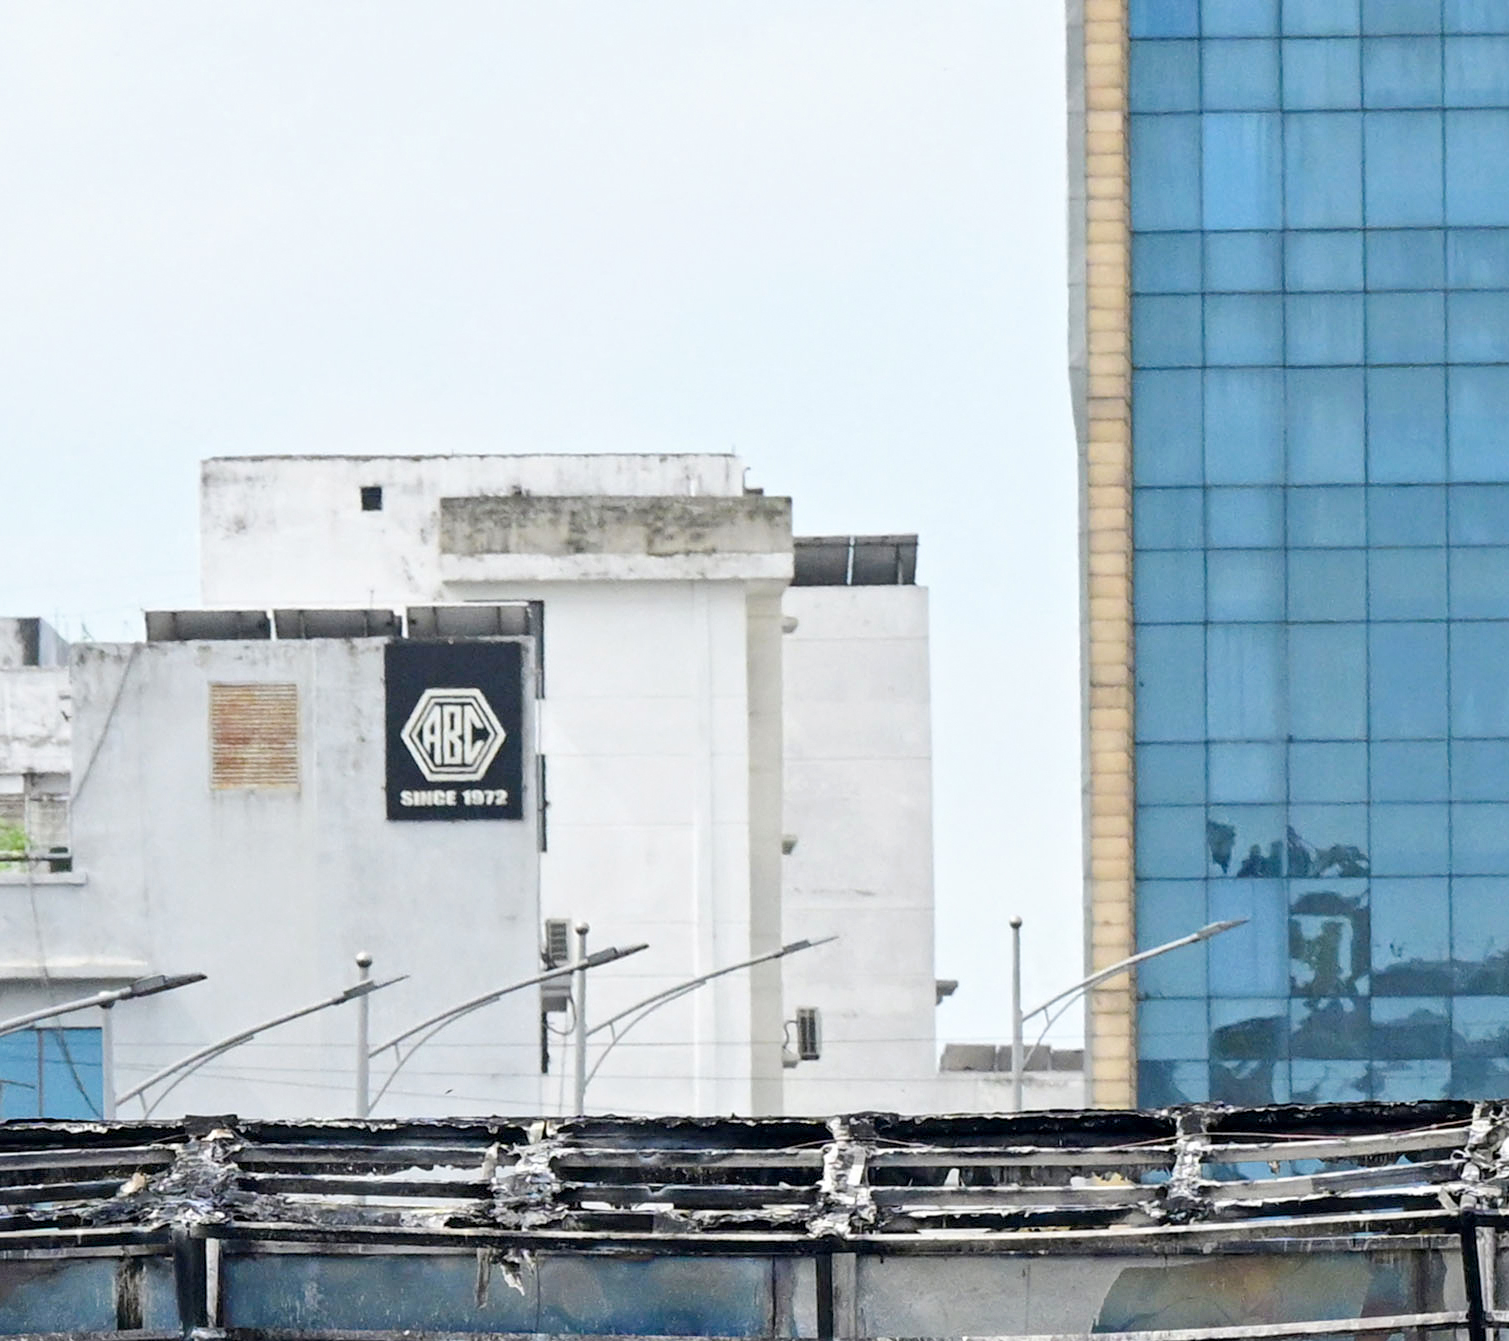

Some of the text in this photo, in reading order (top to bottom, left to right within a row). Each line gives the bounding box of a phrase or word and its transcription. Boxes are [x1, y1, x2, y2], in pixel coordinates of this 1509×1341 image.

[422, 703, 485, 766] ABC
[399, 788, 509, 807] SINCE 1972
